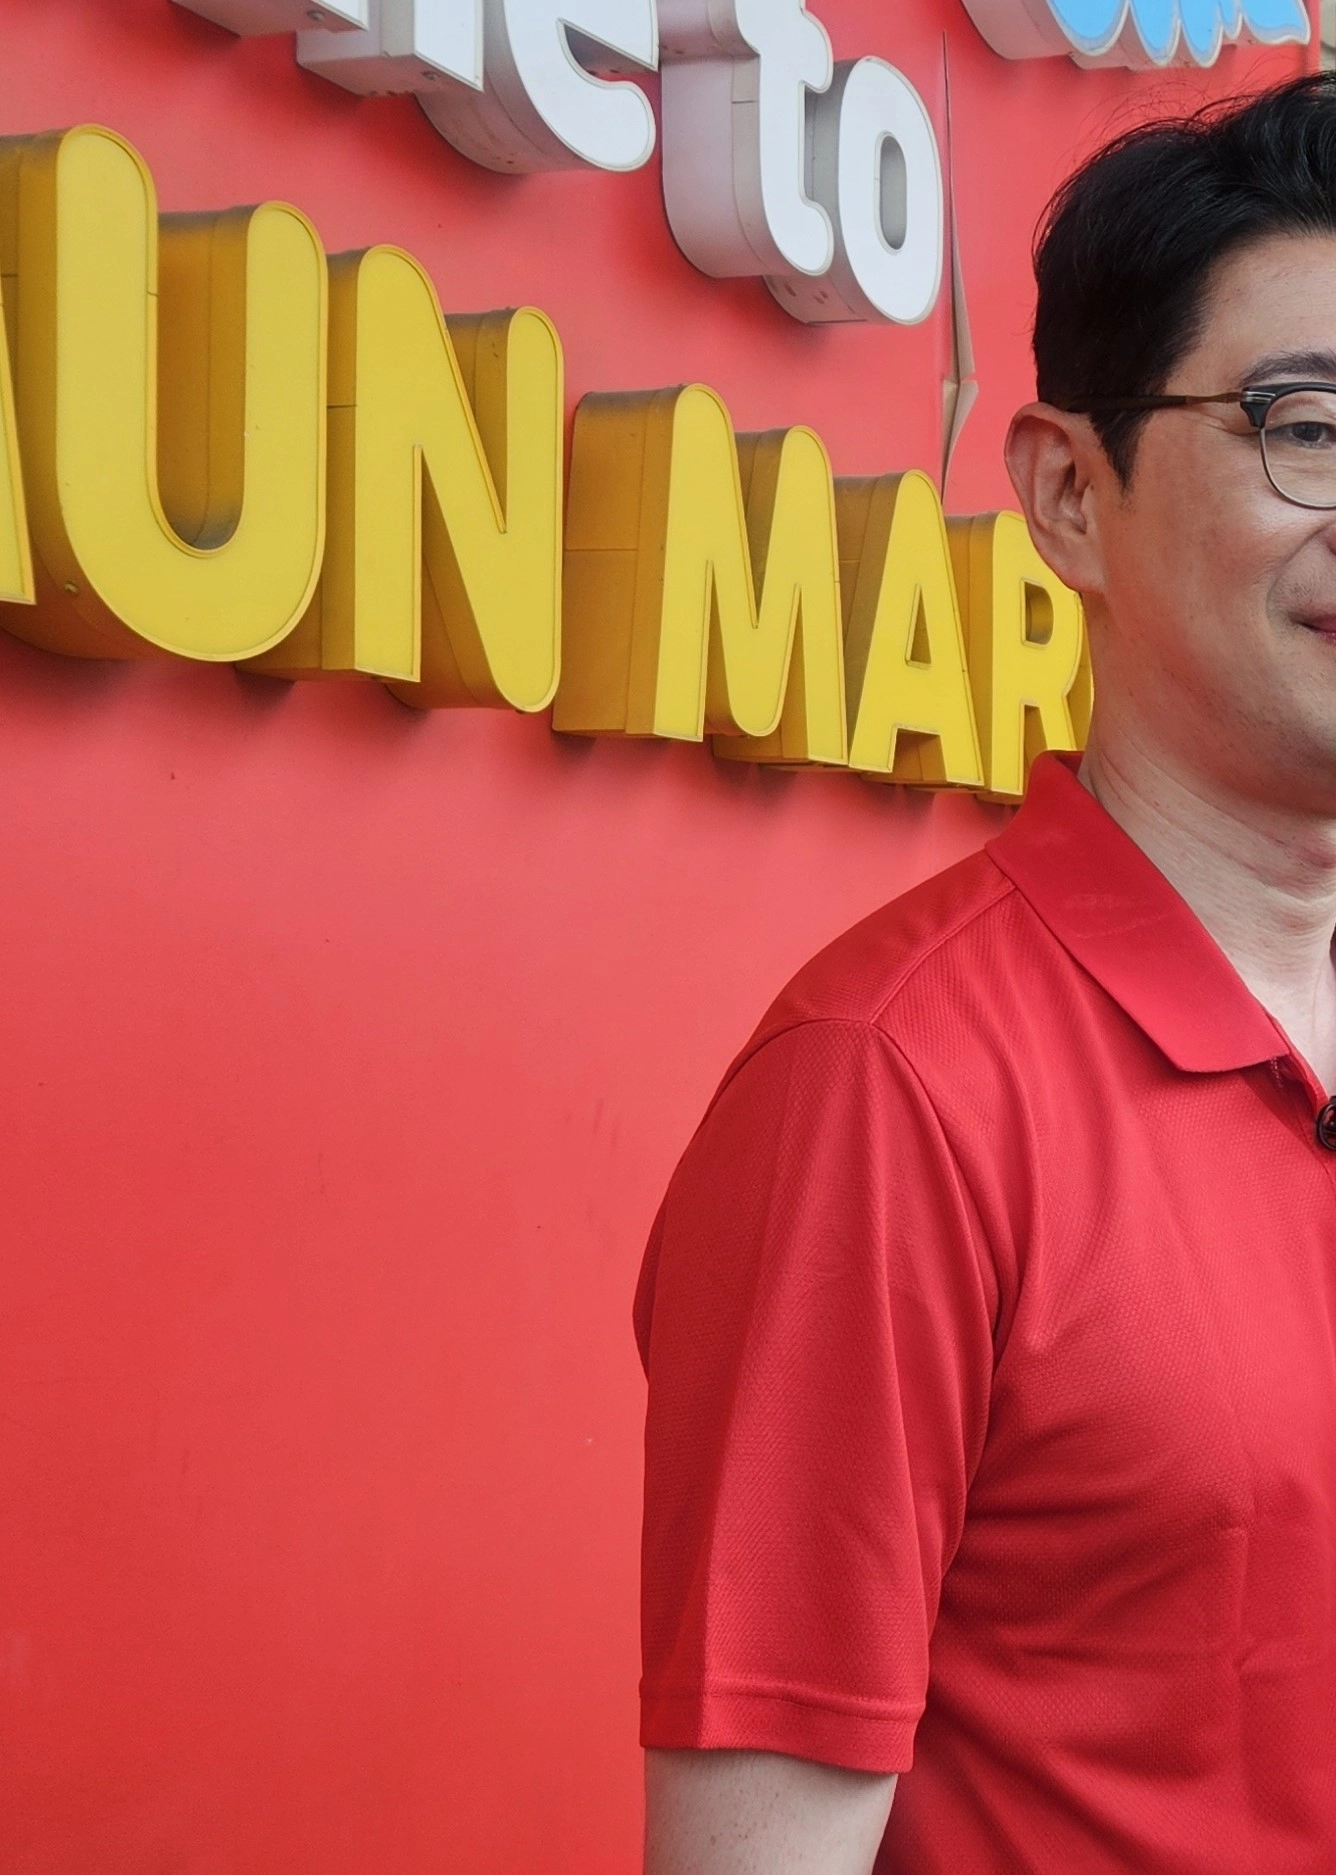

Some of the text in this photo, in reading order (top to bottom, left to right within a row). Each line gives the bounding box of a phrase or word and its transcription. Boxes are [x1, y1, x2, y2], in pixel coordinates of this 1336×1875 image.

[734, 0, 943, 325] to
[0, 123, 1090, 796] UN MAR
